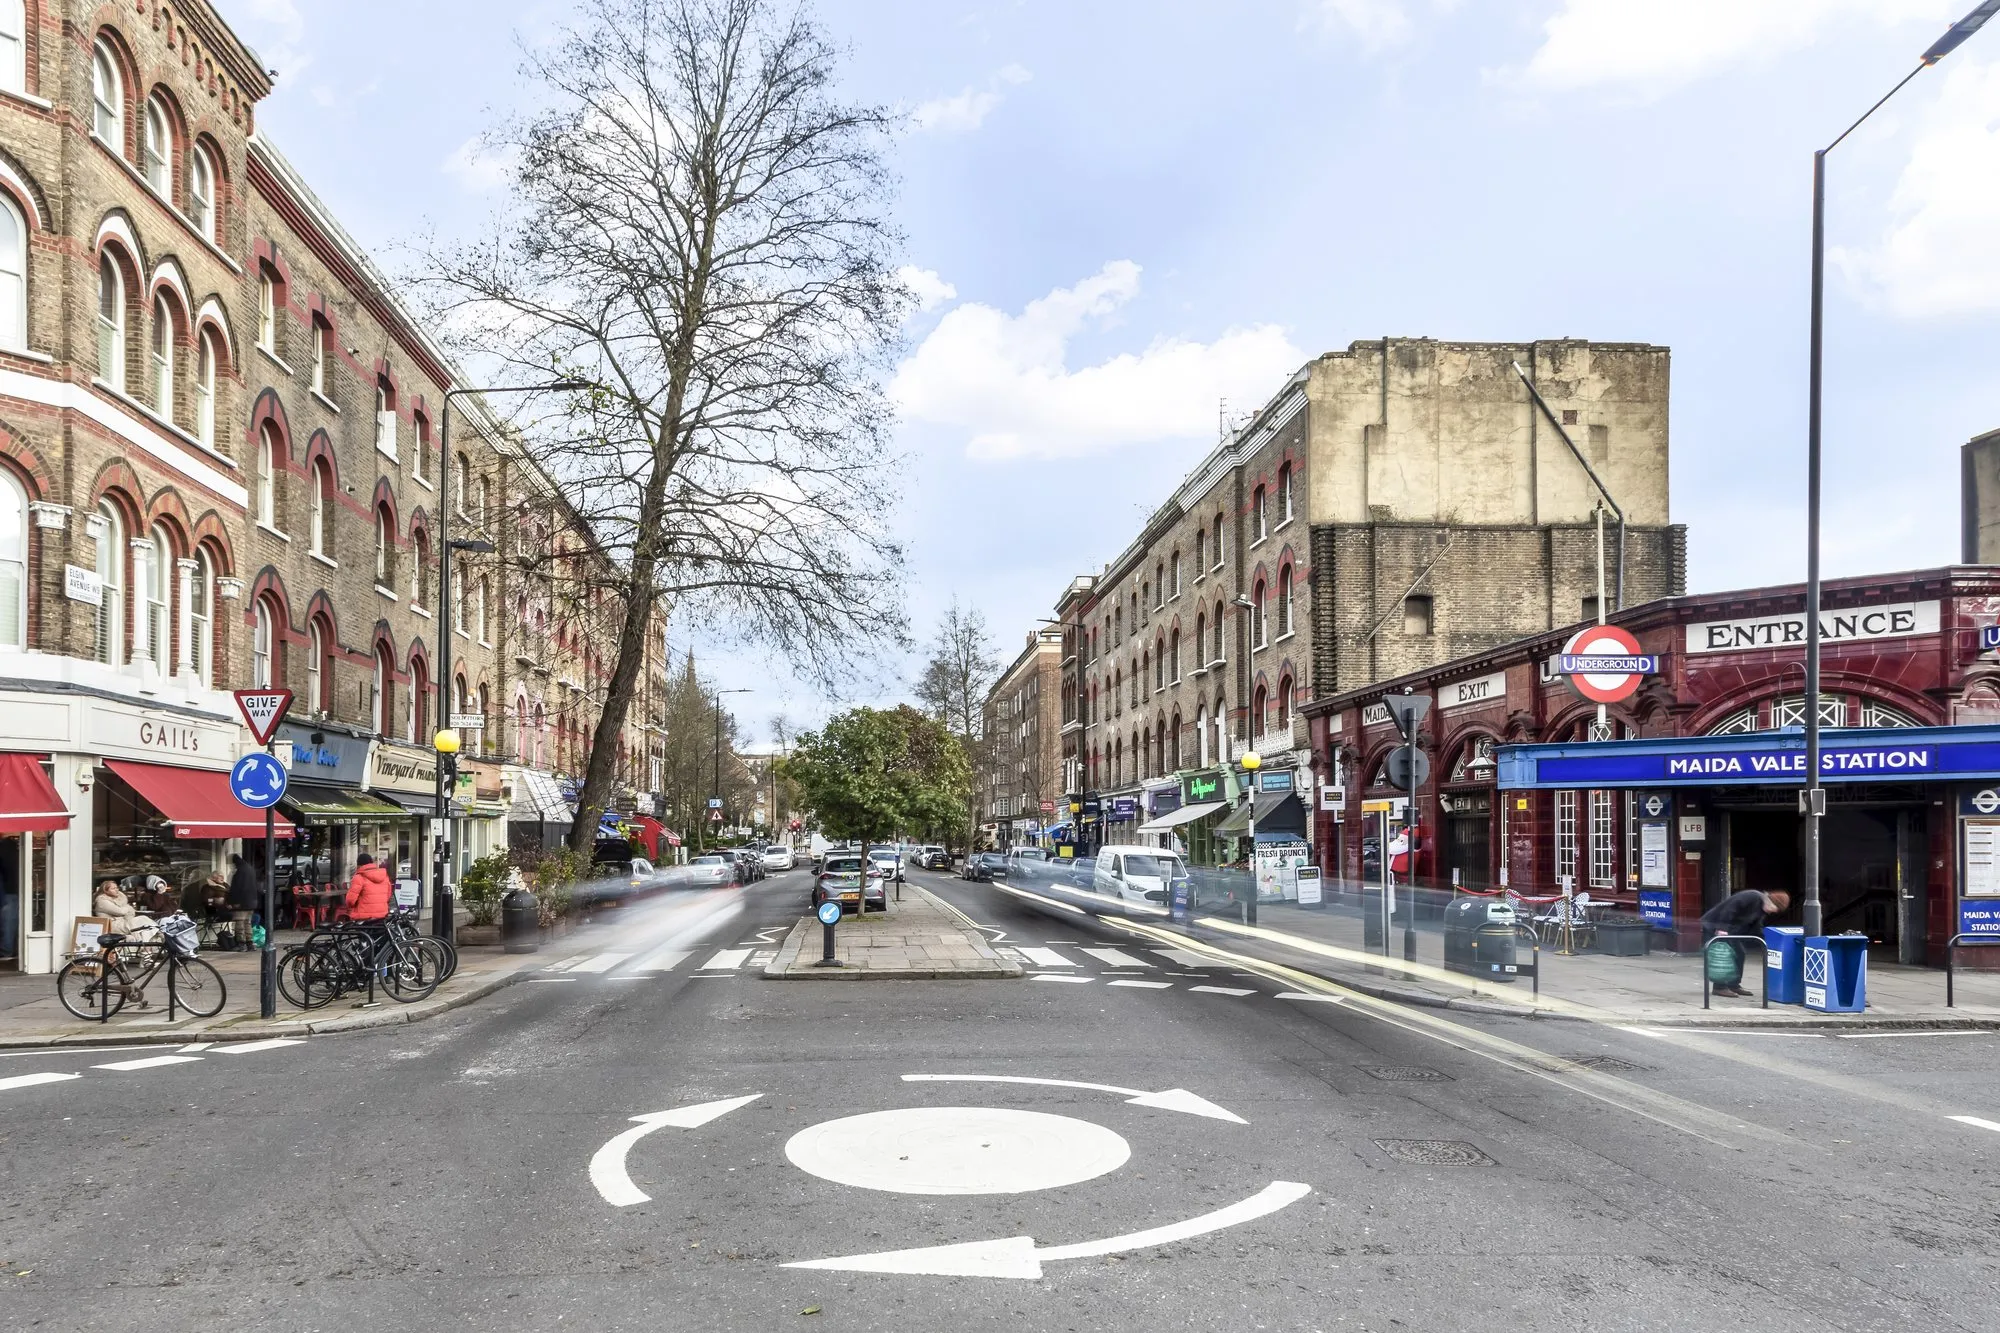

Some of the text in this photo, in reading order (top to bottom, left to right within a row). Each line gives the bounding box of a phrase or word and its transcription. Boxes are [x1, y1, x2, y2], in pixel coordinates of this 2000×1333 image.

[69, 568, 85, 581] ELGIN
[69, 578, 90, 592] AVENUE
[1706, 610, 1916, 649] ENTRANCE
[1563, 656, 1651, 672] UNDERGROUND
[1458, 681, 1489, 702] EXIT
[246, 697, 278, 708] GIVE
[252, 709, 272, 717] WAY
[1670, 751, 1928, 774] MAIDA VALE STATION
[376, 754, 437, 784] Vineyard PHARM
[1684, 824, 1702, 833] LFB
[1257, 848, 1307, 858] FRESH BRUNCH
[1645, 910, 1666, 918] STATION
[1963, 911, 1991, 919] MAIDA
[1971, 923, 2000, 931] STATIO
